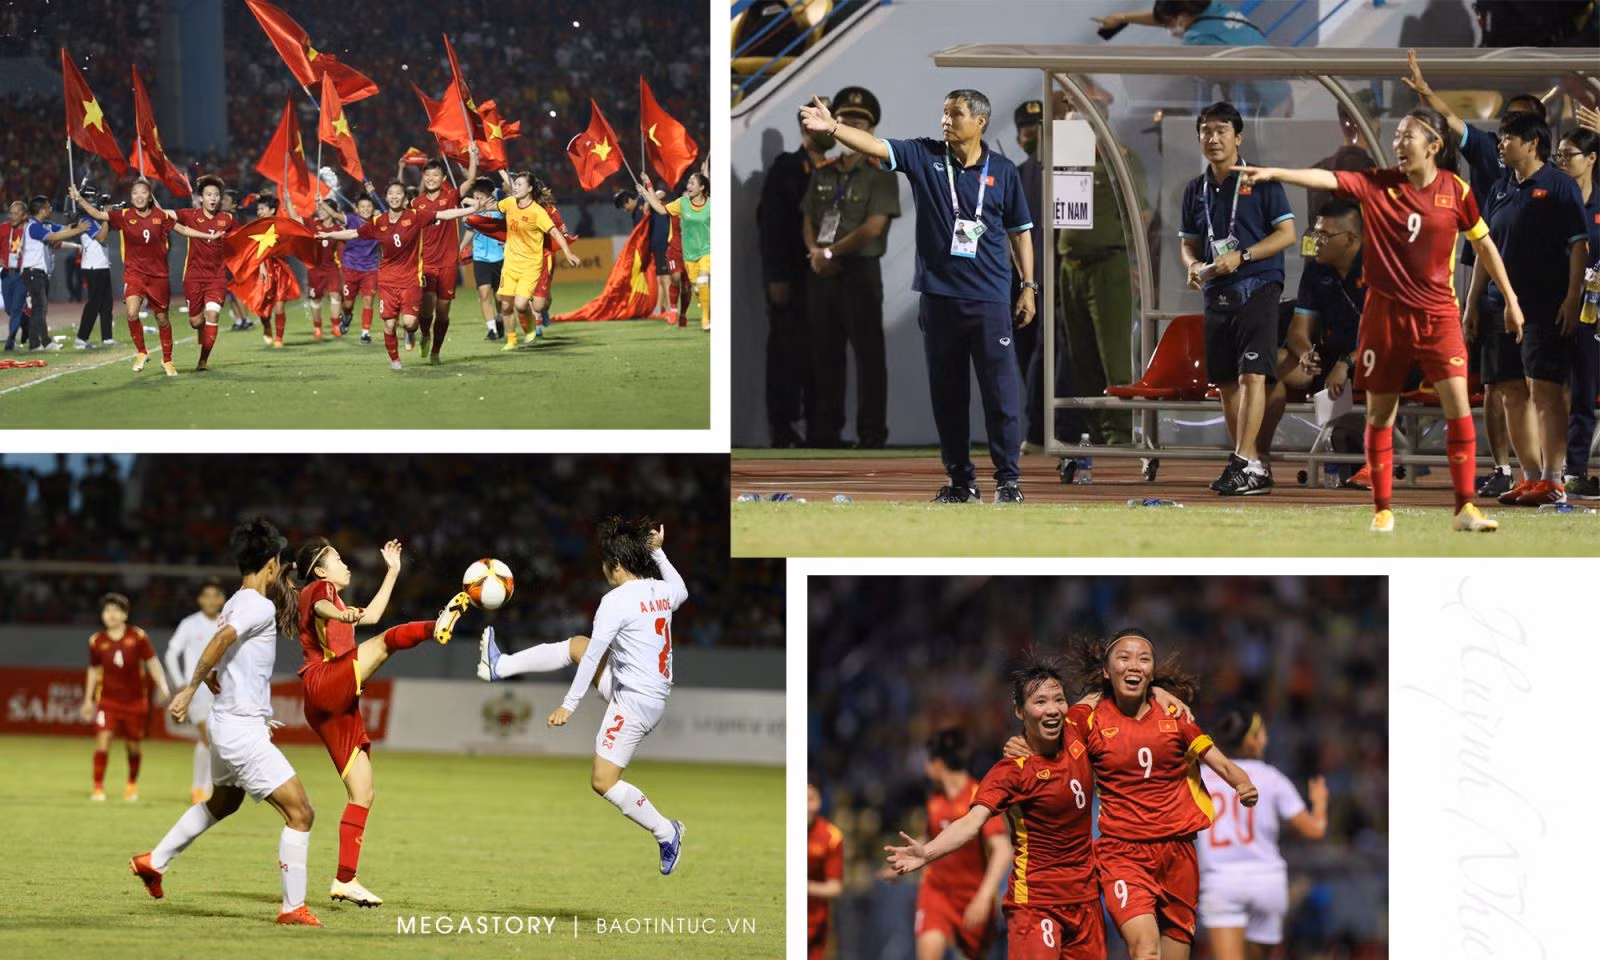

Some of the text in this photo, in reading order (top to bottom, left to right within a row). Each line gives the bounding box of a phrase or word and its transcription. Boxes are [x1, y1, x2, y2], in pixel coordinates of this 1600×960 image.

[1067, 201, 1088, 220] NAM
[143, 229, 150, 243] 9
[393, 233, 401, 247] 8
[1407, 212, 1422, 243] 9
[380, 299, 385, 313] 8
[1363, 349, 1376, 377] 9
[640, 599, 672, 613] A A MOE
[113, 649, 124, 668] 4
[606, 714, 625, 742] 2
[1137, 747, 1153, 779] 9
[1069, 778, 1086, 809] 8
[1208, 790, 1255, 849] 20
[1113, 879, 1128, 909] 9
[1040, 918, 1055, 948] 8
